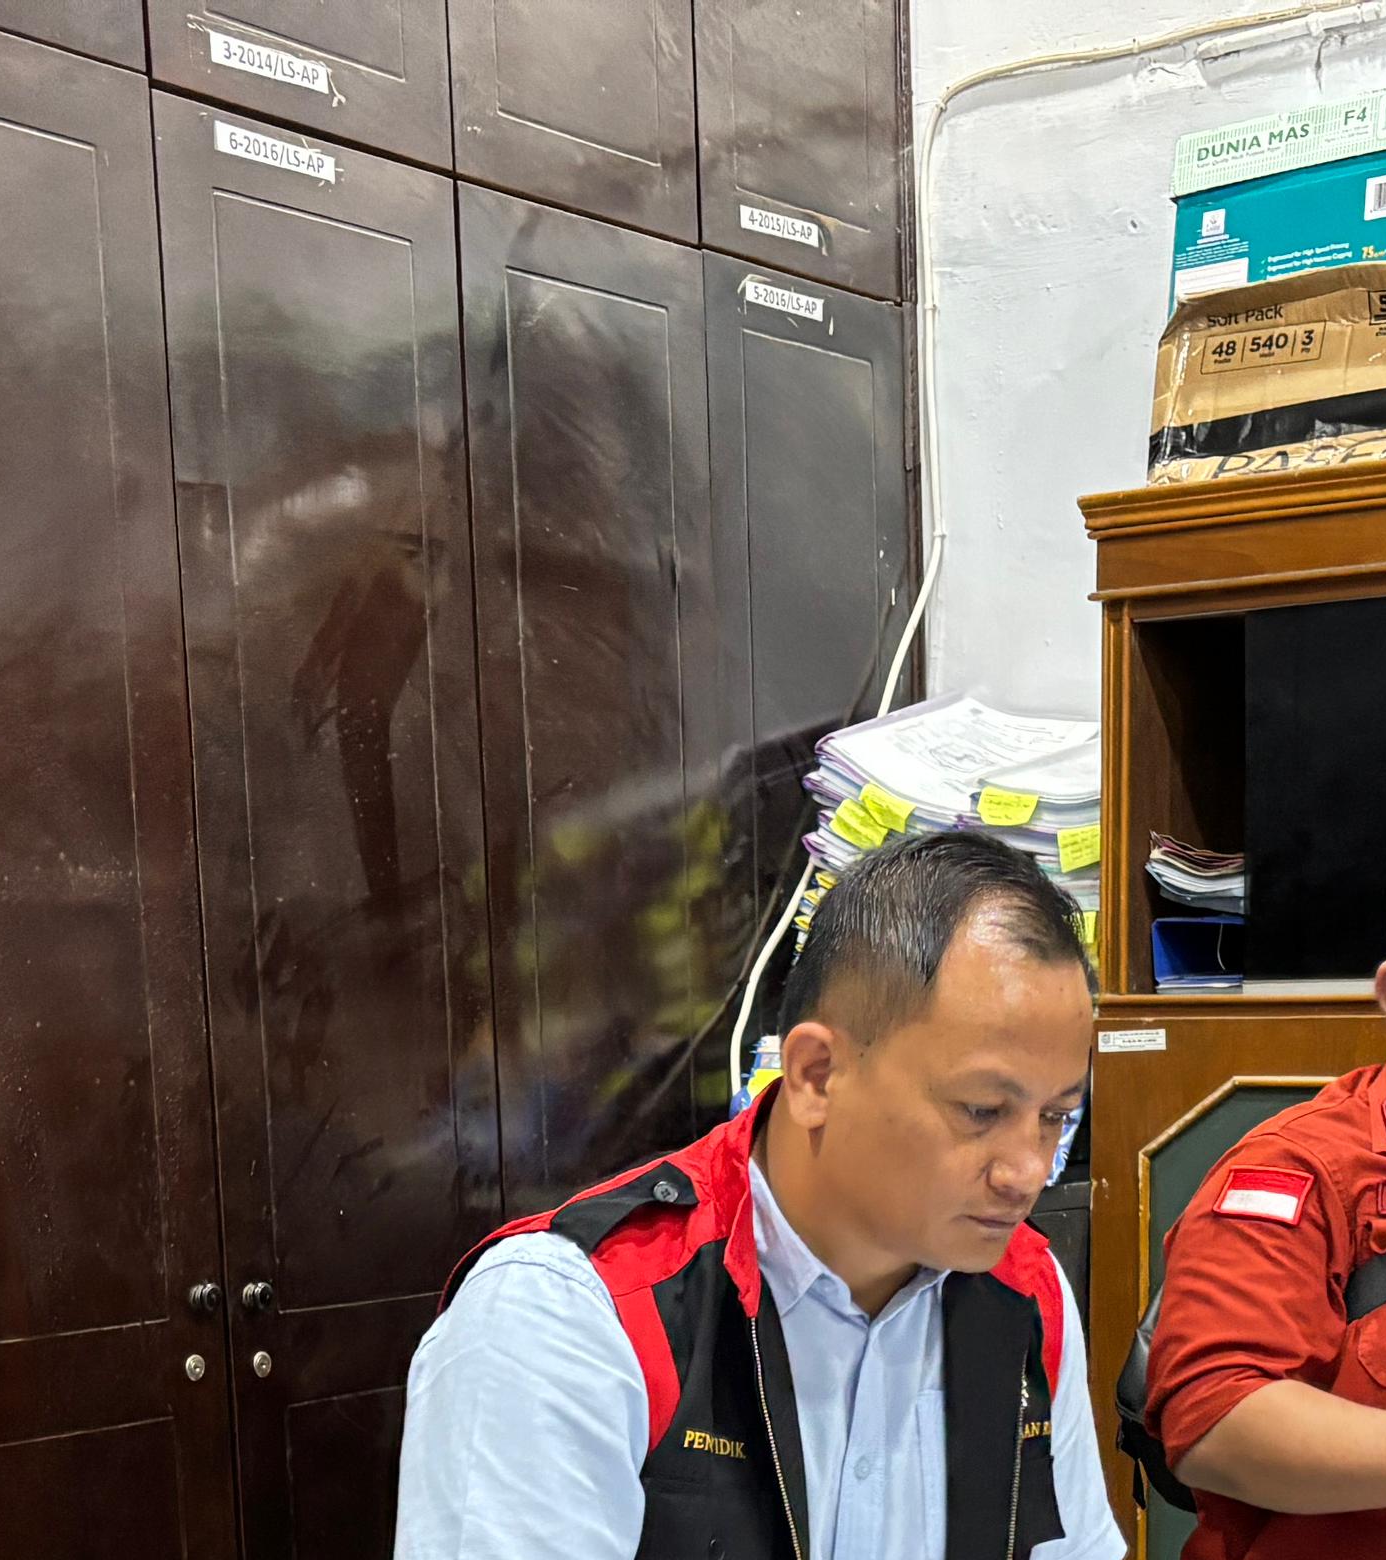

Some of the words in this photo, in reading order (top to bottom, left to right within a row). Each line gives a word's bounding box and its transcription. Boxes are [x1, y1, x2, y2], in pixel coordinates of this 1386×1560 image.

[222, 41, 319, 86] 3-2014/LS-AP
[1343, 107, 1367, 125] F4
[229, 131, 324, 174] 6-2016/LS-AP
[1197, 135, 1261, 162] DUNIA
[1268, 123, 1310, 145] MAS
[748, 210, 812, 241] 4-2015/LS-AP
[753, 286, 817, 317] 5-2016/LS-AP
[1245, 305, 1284, 324] Pack
[1211, 341, 1237, 358] 48
[1249, 333, 1288, 351] 540
[1301, 330, 1314, 346] 3
